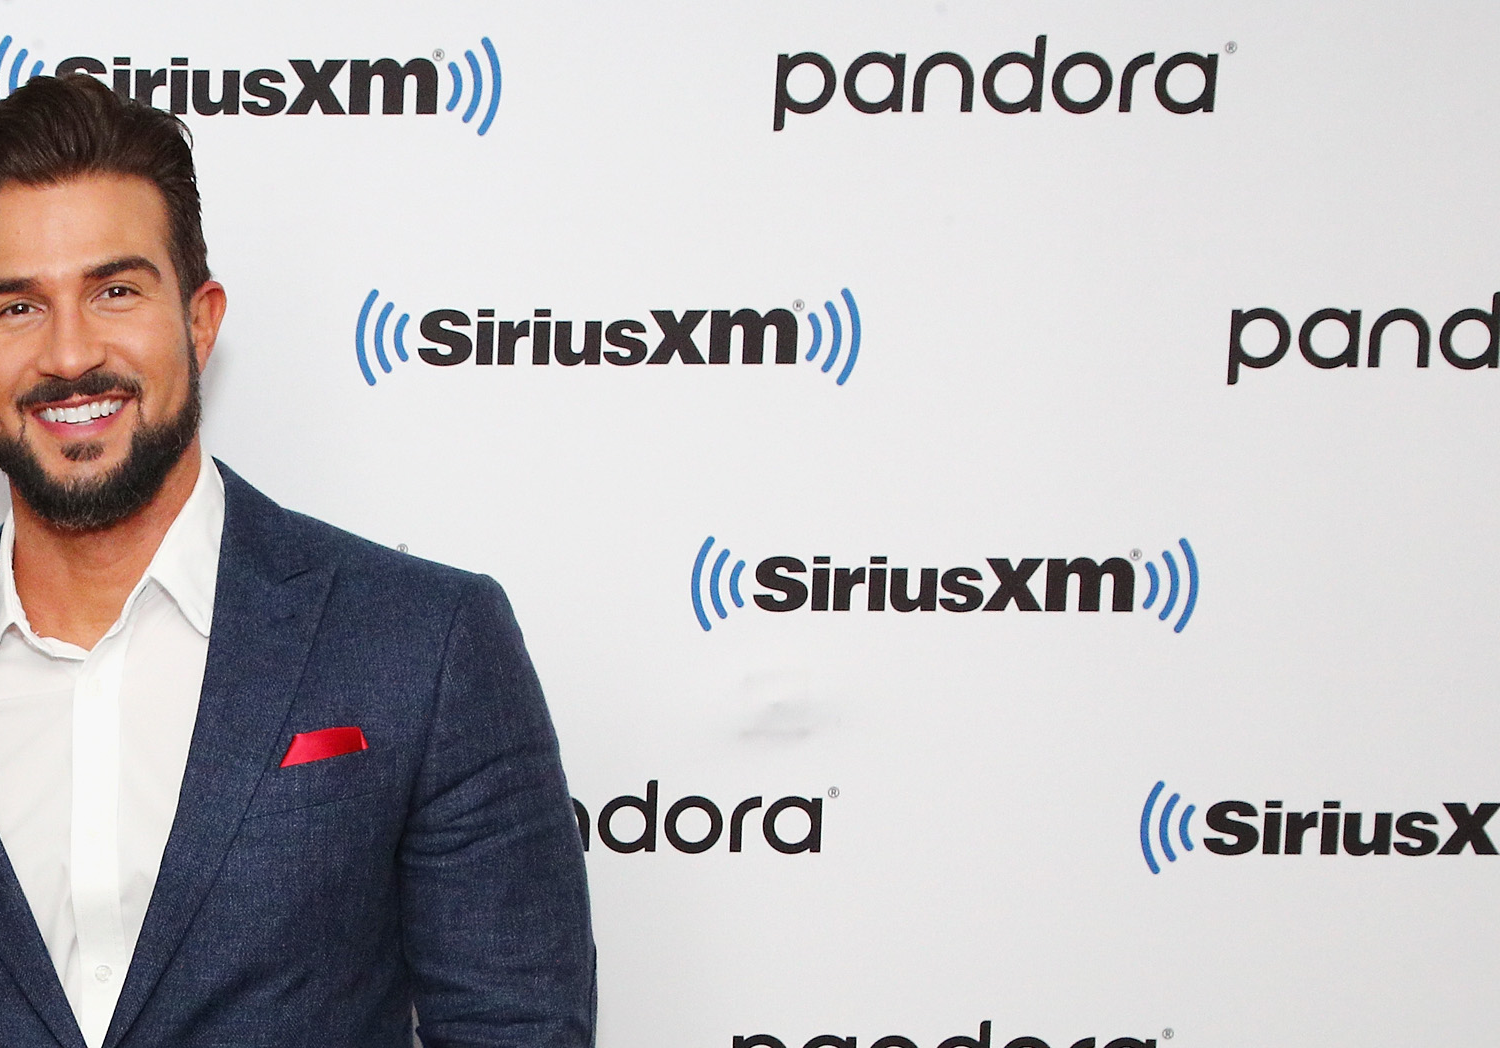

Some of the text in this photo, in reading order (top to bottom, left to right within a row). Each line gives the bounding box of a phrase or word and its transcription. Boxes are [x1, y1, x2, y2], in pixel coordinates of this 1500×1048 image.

[774, 35, 1218, 131] pandora
[1227, 292, 1500, 385] pand
[1204, 801, 1500, 856] SiriusX
